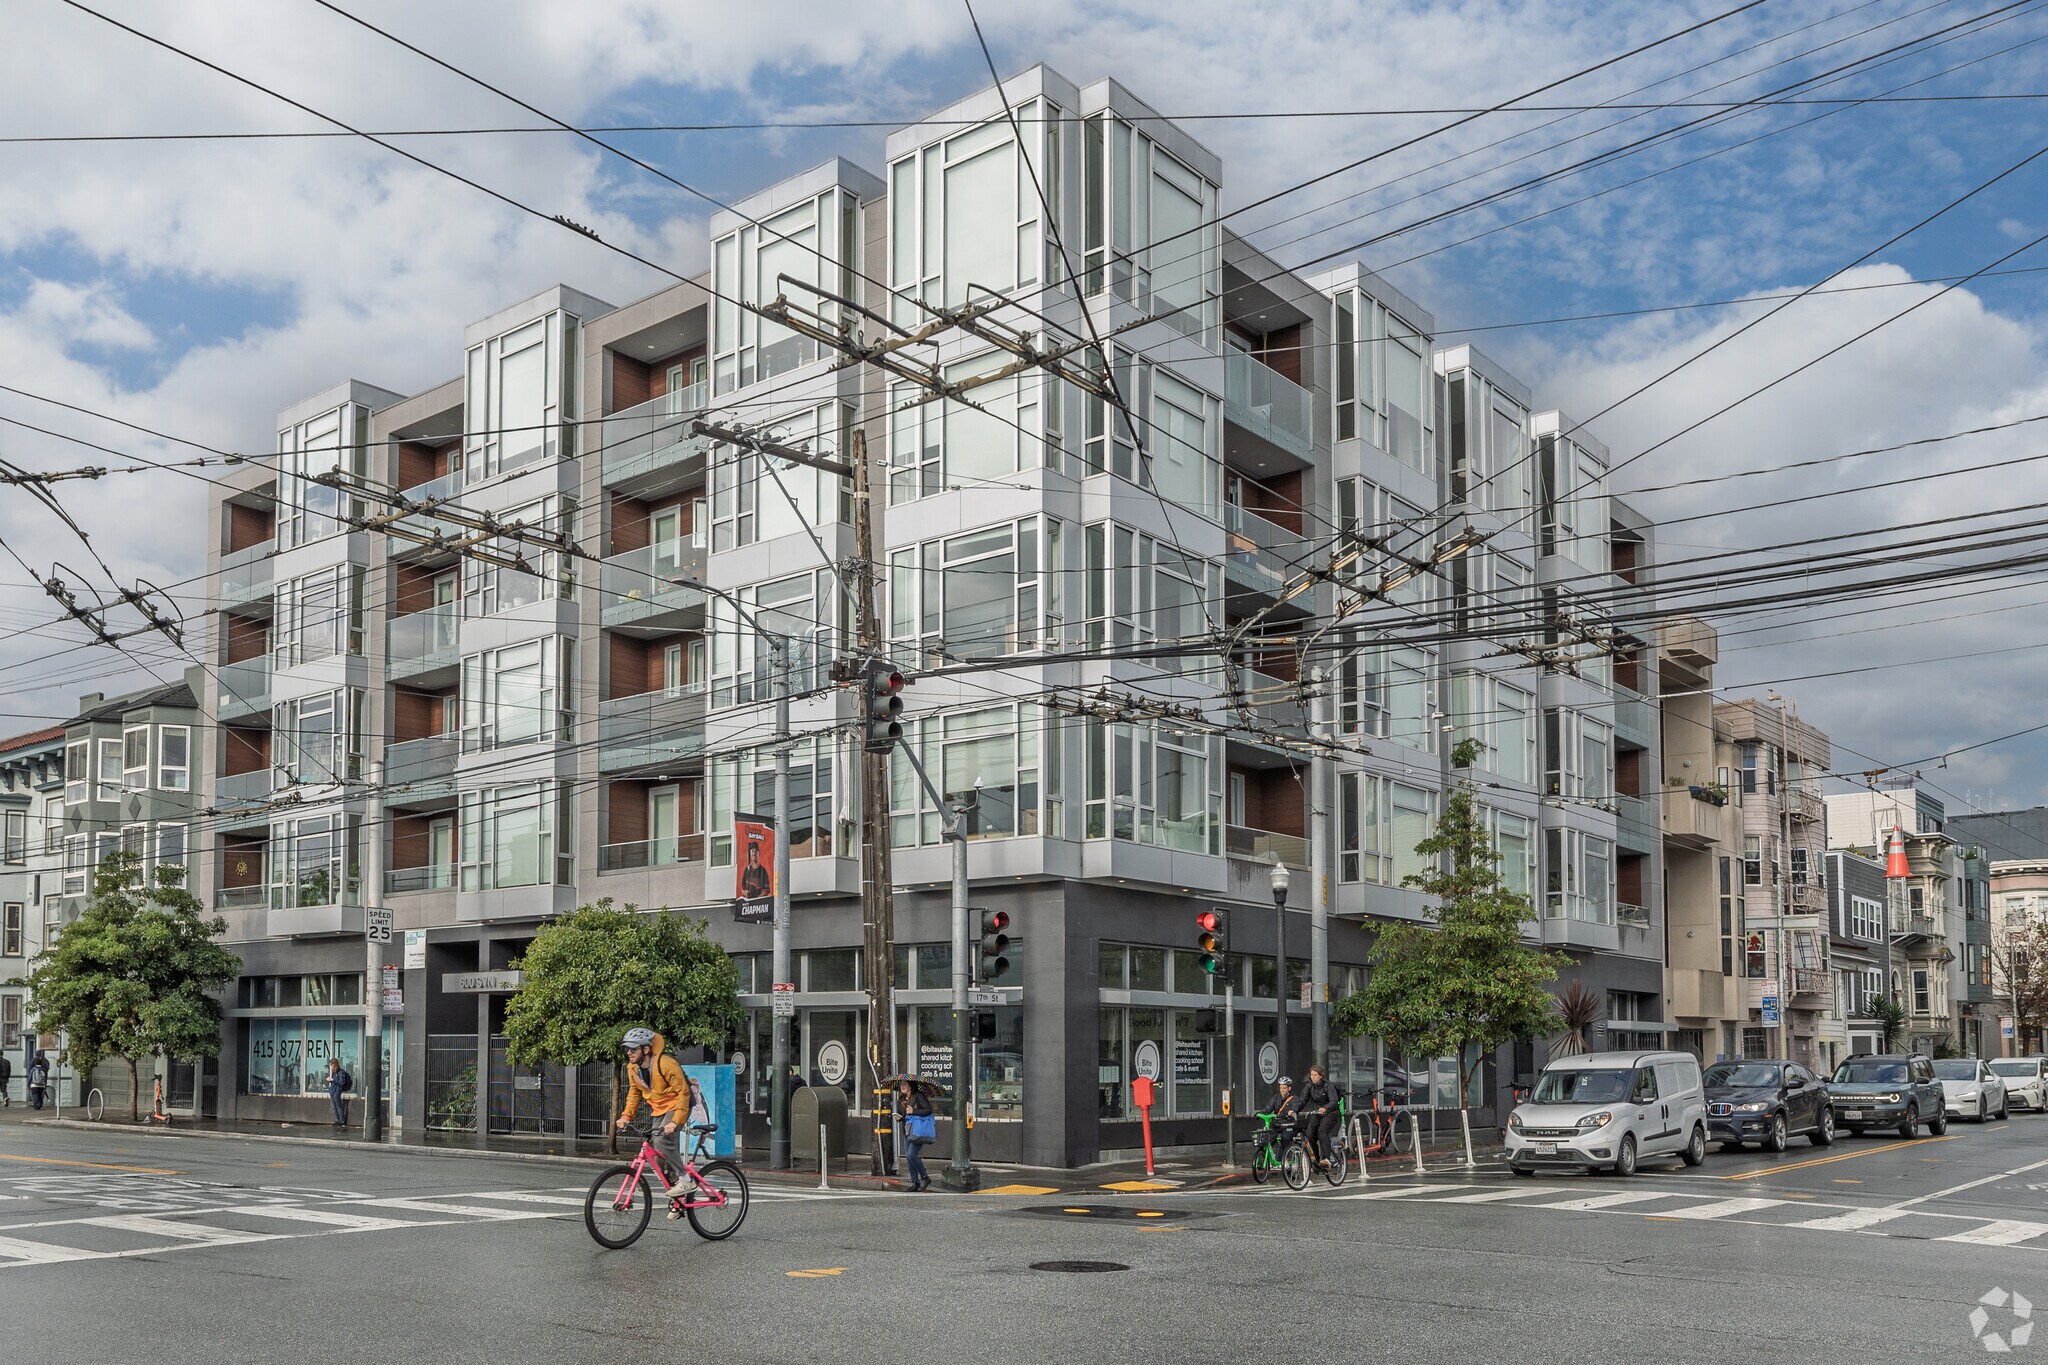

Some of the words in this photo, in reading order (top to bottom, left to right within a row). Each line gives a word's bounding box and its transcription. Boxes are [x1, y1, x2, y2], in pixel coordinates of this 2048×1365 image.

[741, 904, 769, 916] CHAPMAN
[368, 911, 391, 919] SPEED
[371, 918, 389, 926] LIMIT
[368, 926, 390, 940] 25
[976, 994, 988, 1002] 17th
[991, 994, 999, 1003] St
[920, 1062, 942, 1071] cooking
